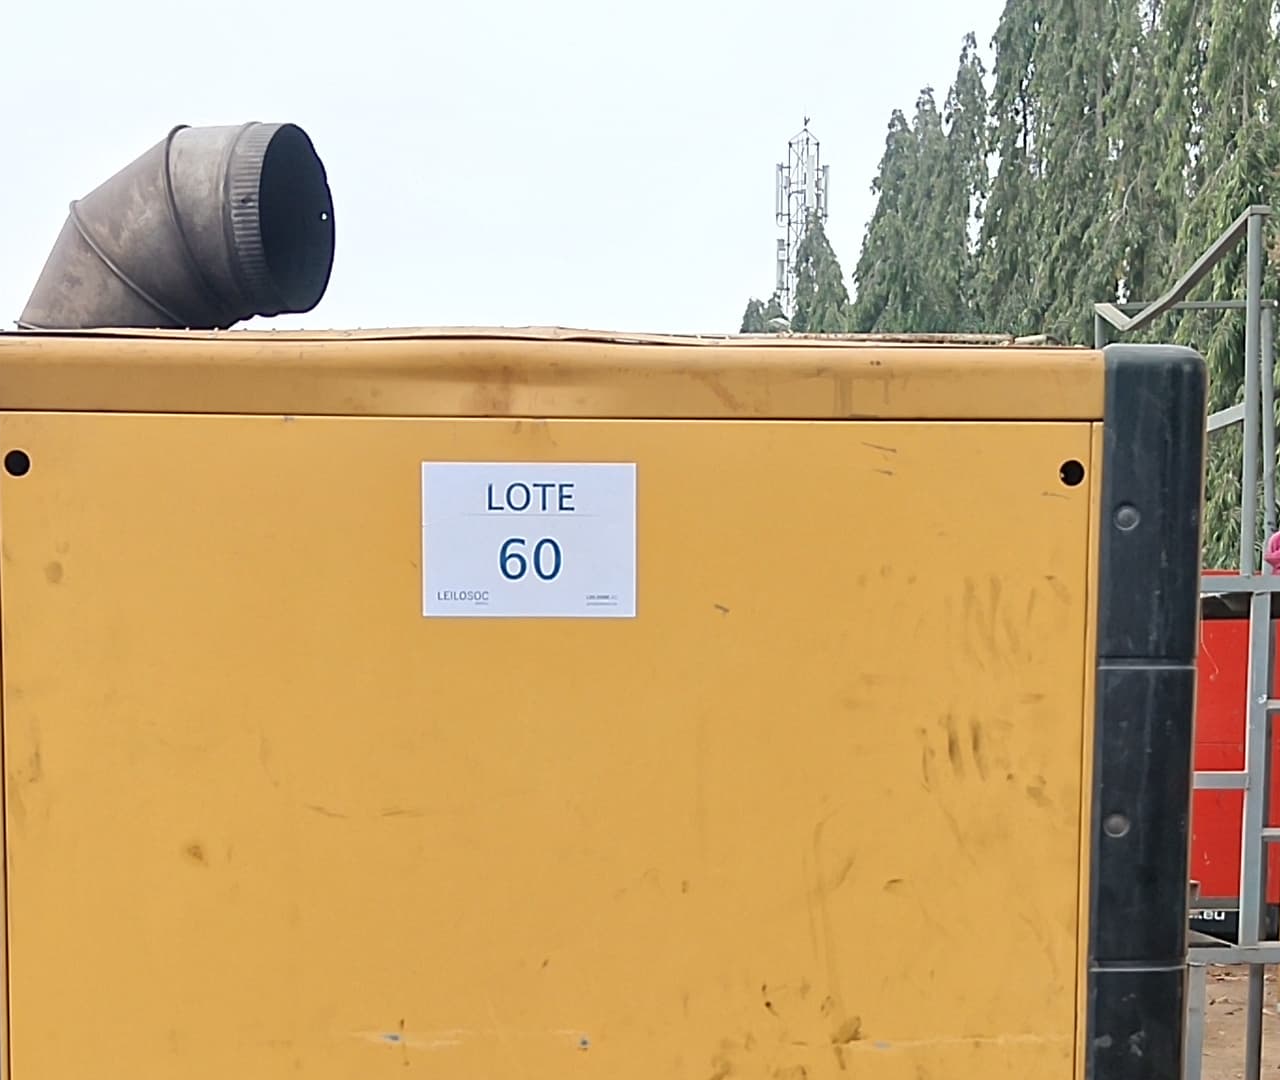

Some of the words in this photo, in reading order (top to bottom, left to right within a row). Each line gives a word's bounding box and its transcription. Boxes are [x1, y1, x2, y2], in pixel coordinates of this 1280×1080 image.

[486, 482, 576, 512] LOTE
[498, 537, 563, 581] 60
[436, 590, 490, 602] LEILOSOC
